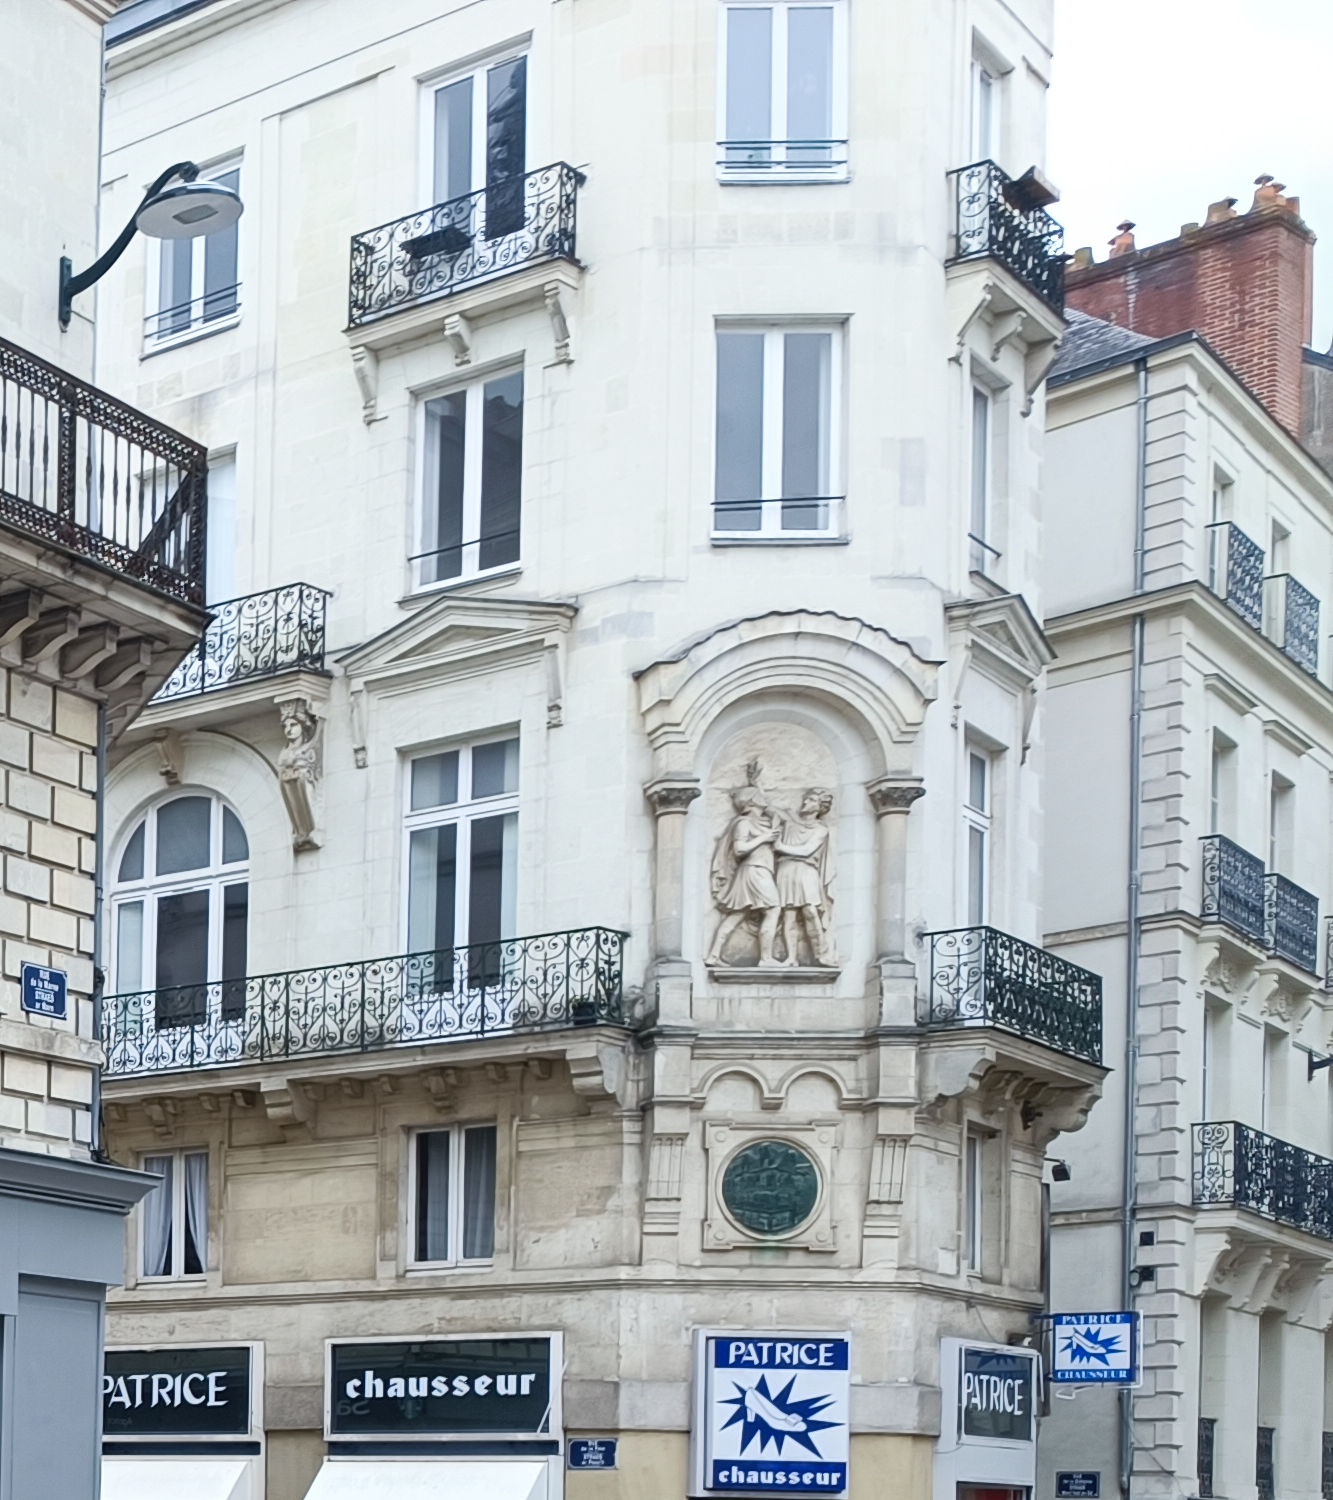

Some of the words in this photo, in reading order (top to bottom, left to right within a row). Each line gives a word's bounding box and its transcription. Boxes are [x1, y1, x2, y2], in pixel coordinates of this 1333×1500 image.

[1062, 1314, 1125, 1325] PATRICE
[729, 1341, 835, 1366] PATRICE
[346, 1370, 536, 1399] chausseur
[1057, 1370, 1128, 1380] CHAUSSEUR
[102, 1371, 230, 1410] PATRICE
[963, 1372, 1024, 1416] PATRICE
[718, 1466, 842, 1486] chausseur
